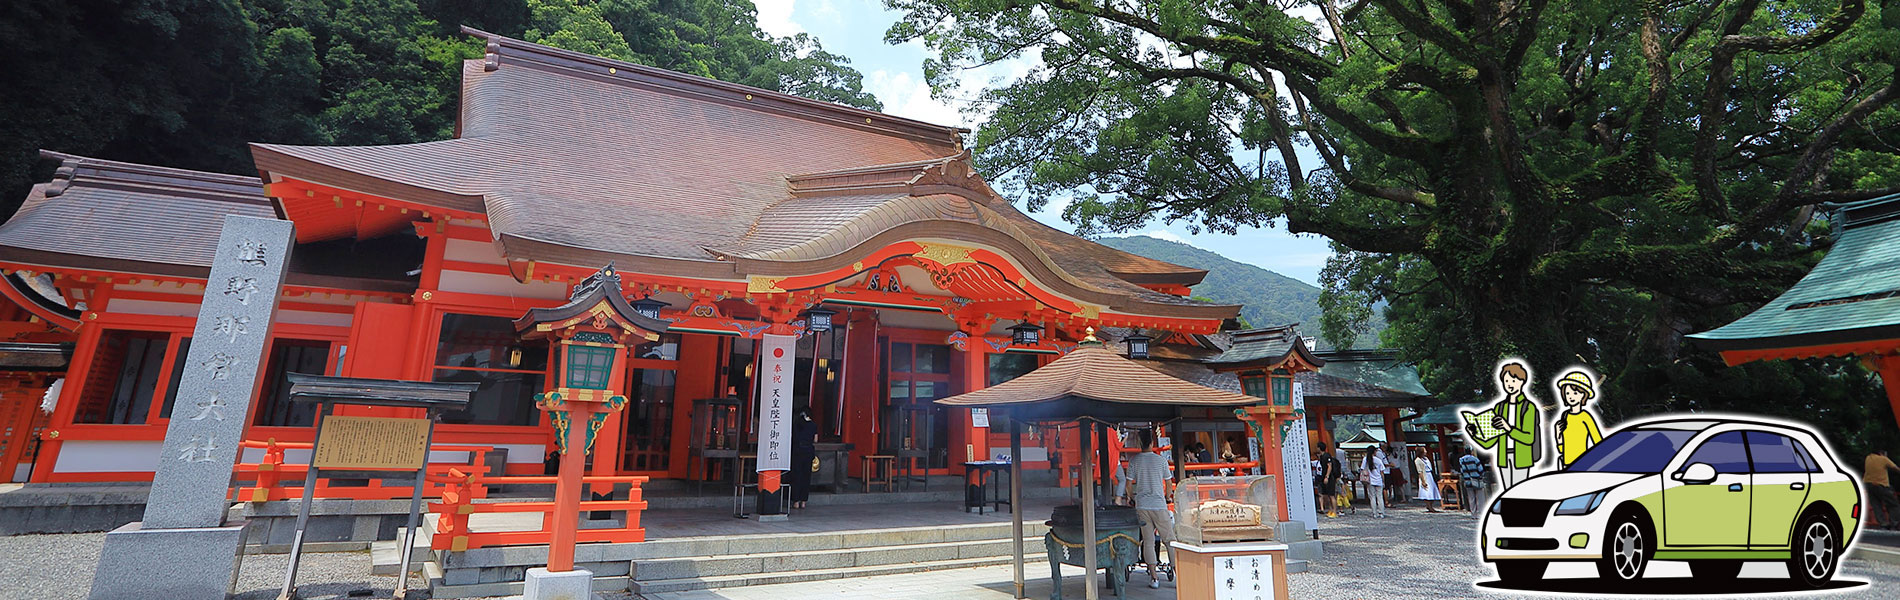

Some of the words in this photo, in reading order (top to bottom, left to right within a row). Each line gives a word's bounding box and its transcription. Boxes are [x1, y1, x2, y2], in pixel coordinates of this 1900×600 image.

[178, 239, 267, 463] 熊野那智大社
[1224, 558, 1235, 600] 護摩
